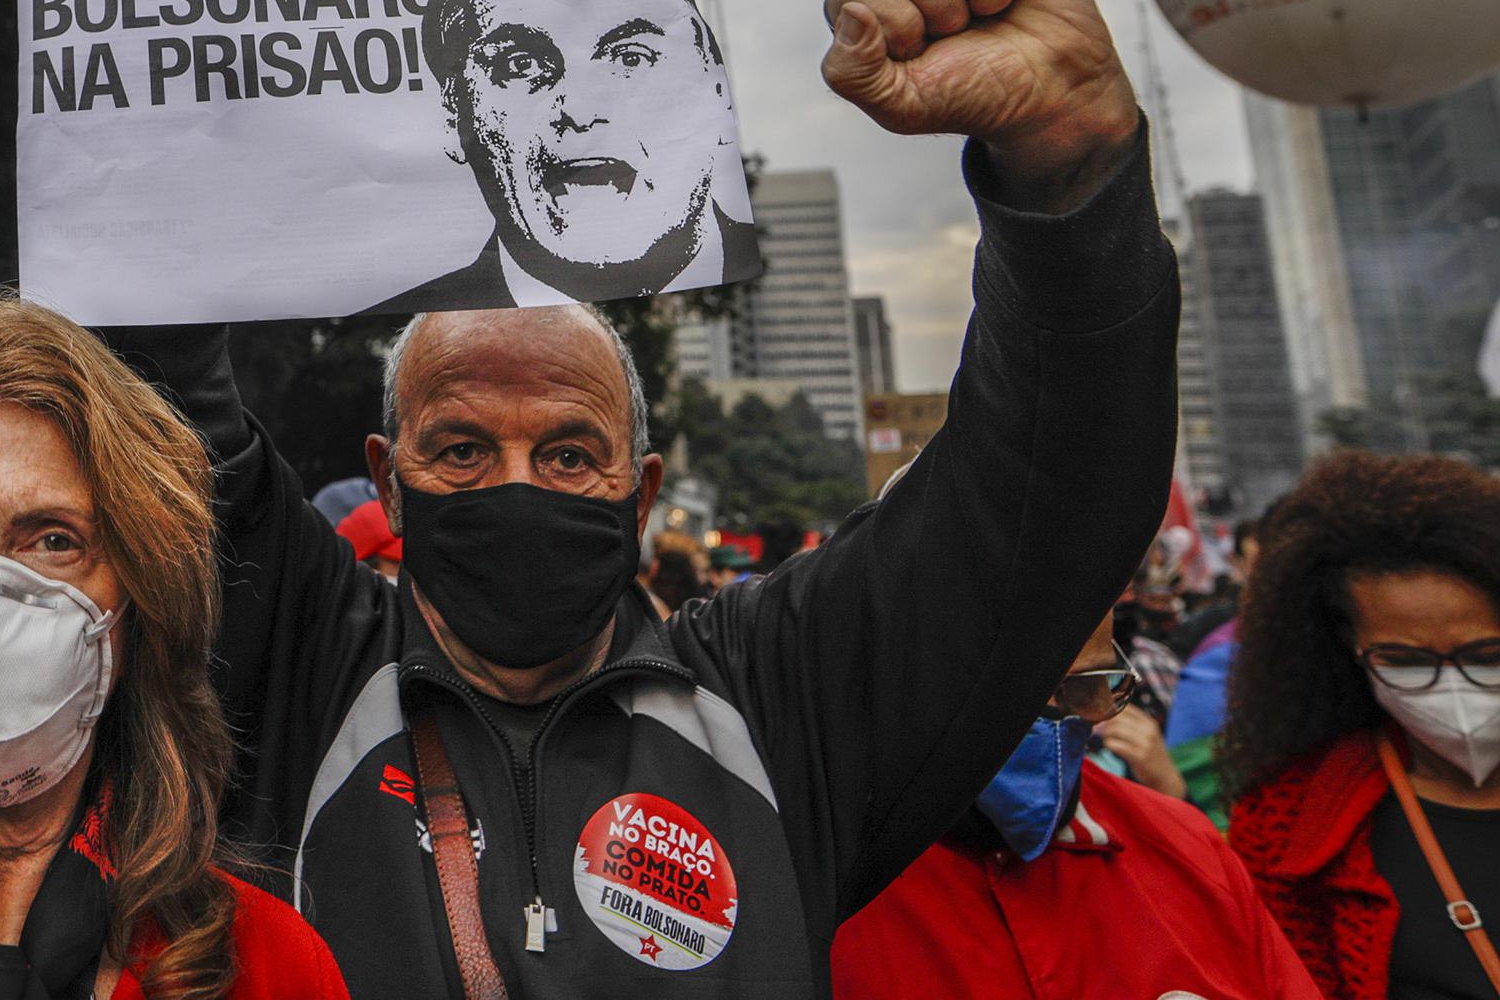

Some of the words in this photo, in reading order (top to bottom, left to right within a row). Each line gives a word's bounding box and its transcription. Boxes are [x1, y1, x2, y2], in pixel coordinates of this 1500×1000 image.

[31, 42, 130, 114] NA
[609, 822, 640, 843] NO
[645, 834, 716, 879] BRAÇO.
[613, 801, 716, 862] VACINA
[602, 859, 634, 881] NO
[639, 874, 705, 915] PRATO.
[606, 840, 712, 900] COMIDA
[600, 885, 642, 922] FORA
[644, 905, 706, 955] BOLSONARO
[643, 942, 655, 953] PT
